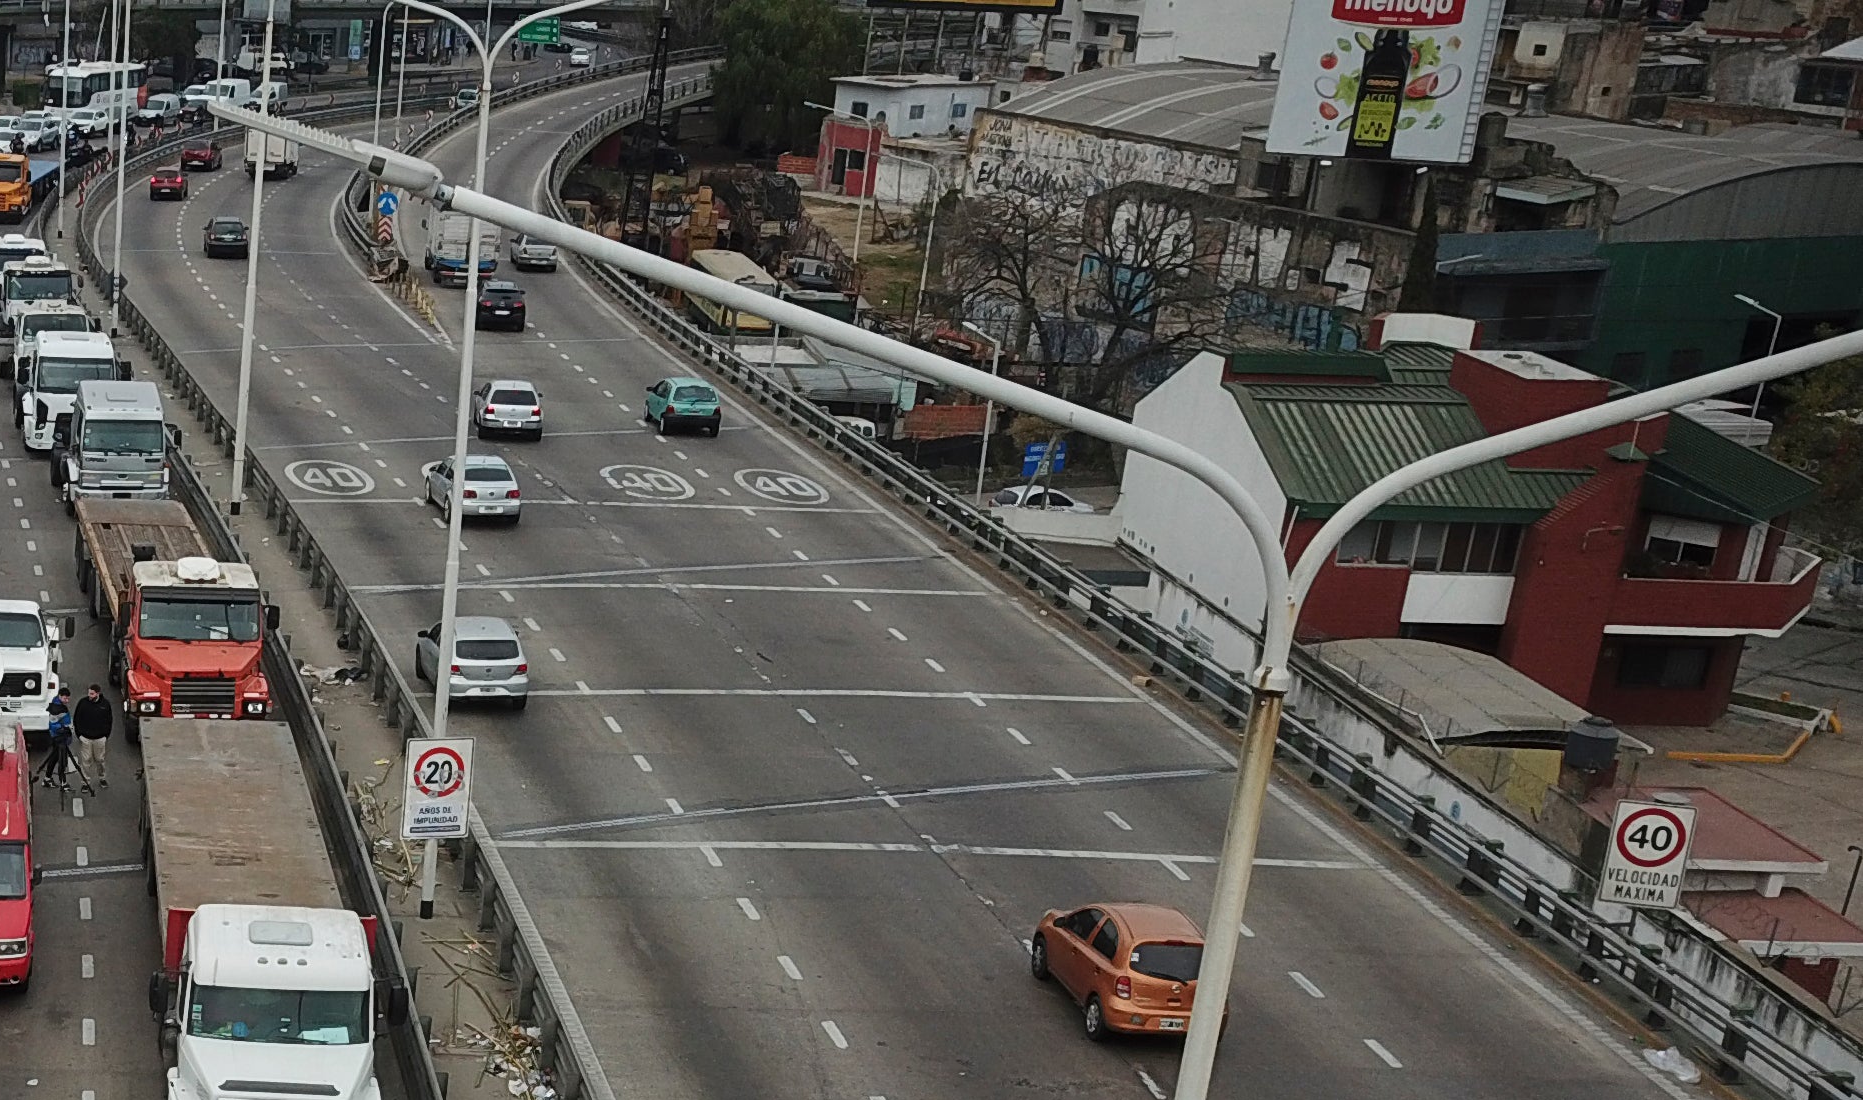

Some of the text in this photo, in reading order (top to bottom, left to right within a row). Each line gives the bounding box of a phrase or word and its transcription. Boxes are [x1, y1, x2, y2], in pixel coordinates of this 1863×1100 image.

[303, 467, 364, 487] 40
[755, 476, 819, 496] 40
[425, 760, 453, 785] 20
[1628, 825, 1673, 852] 40
[1608, 867, 1679, 887] VELOCIDAD
[1614, 884, 1664, 902] MAXIMA
